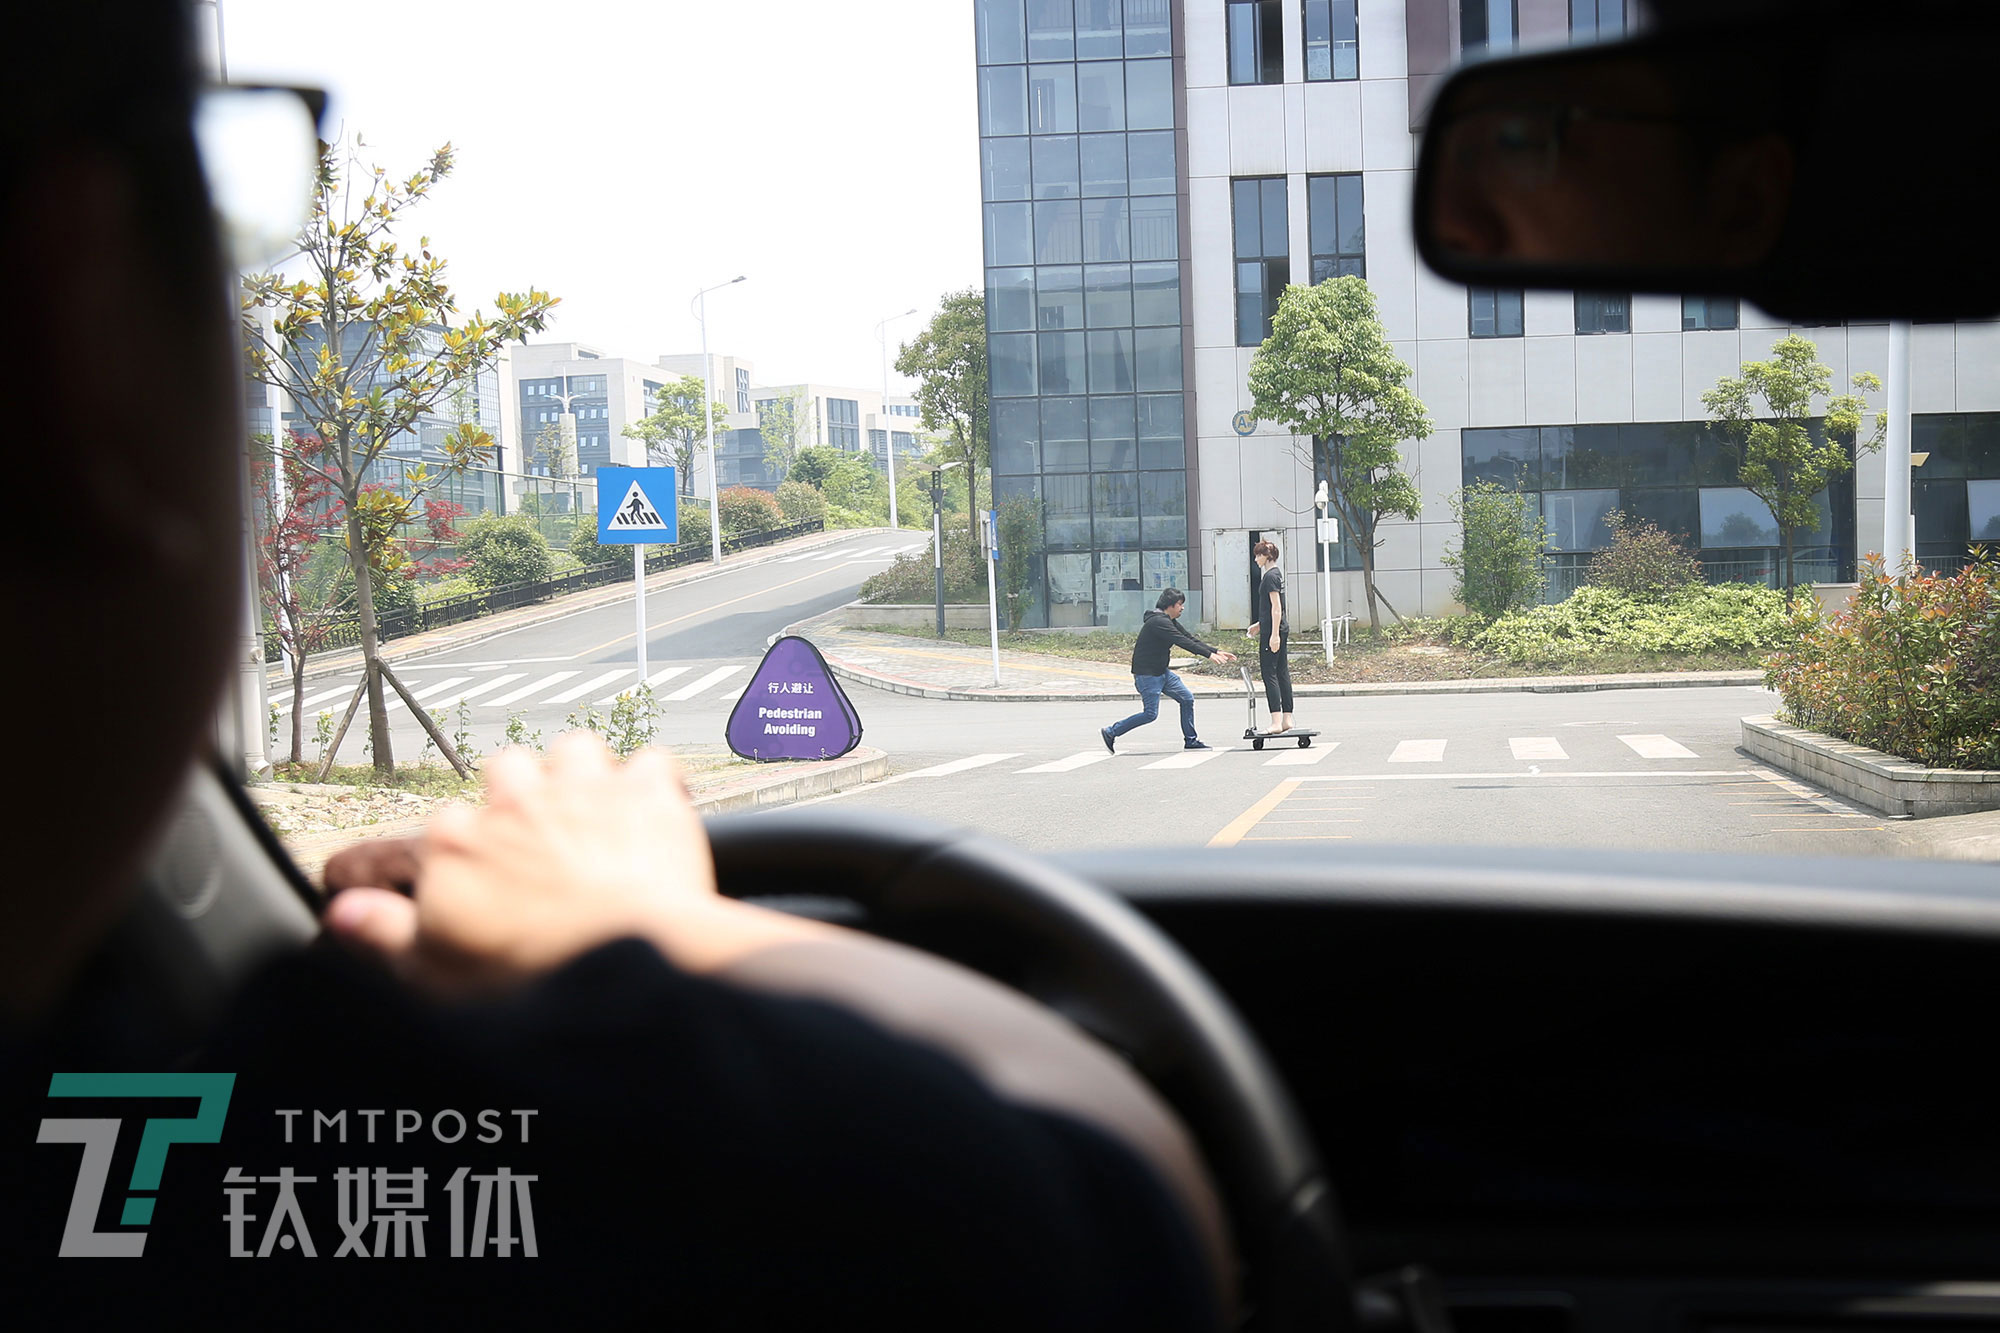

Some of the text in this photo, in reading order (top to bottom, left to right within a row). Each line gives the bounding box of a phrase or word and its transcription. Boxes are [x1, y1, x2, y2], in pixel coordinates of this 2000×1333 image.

[767, 681, 814, 694] 行人避让
[758, 706, 822, 720] Pedestrian
[763, 723, 816, 737] Avoiding
